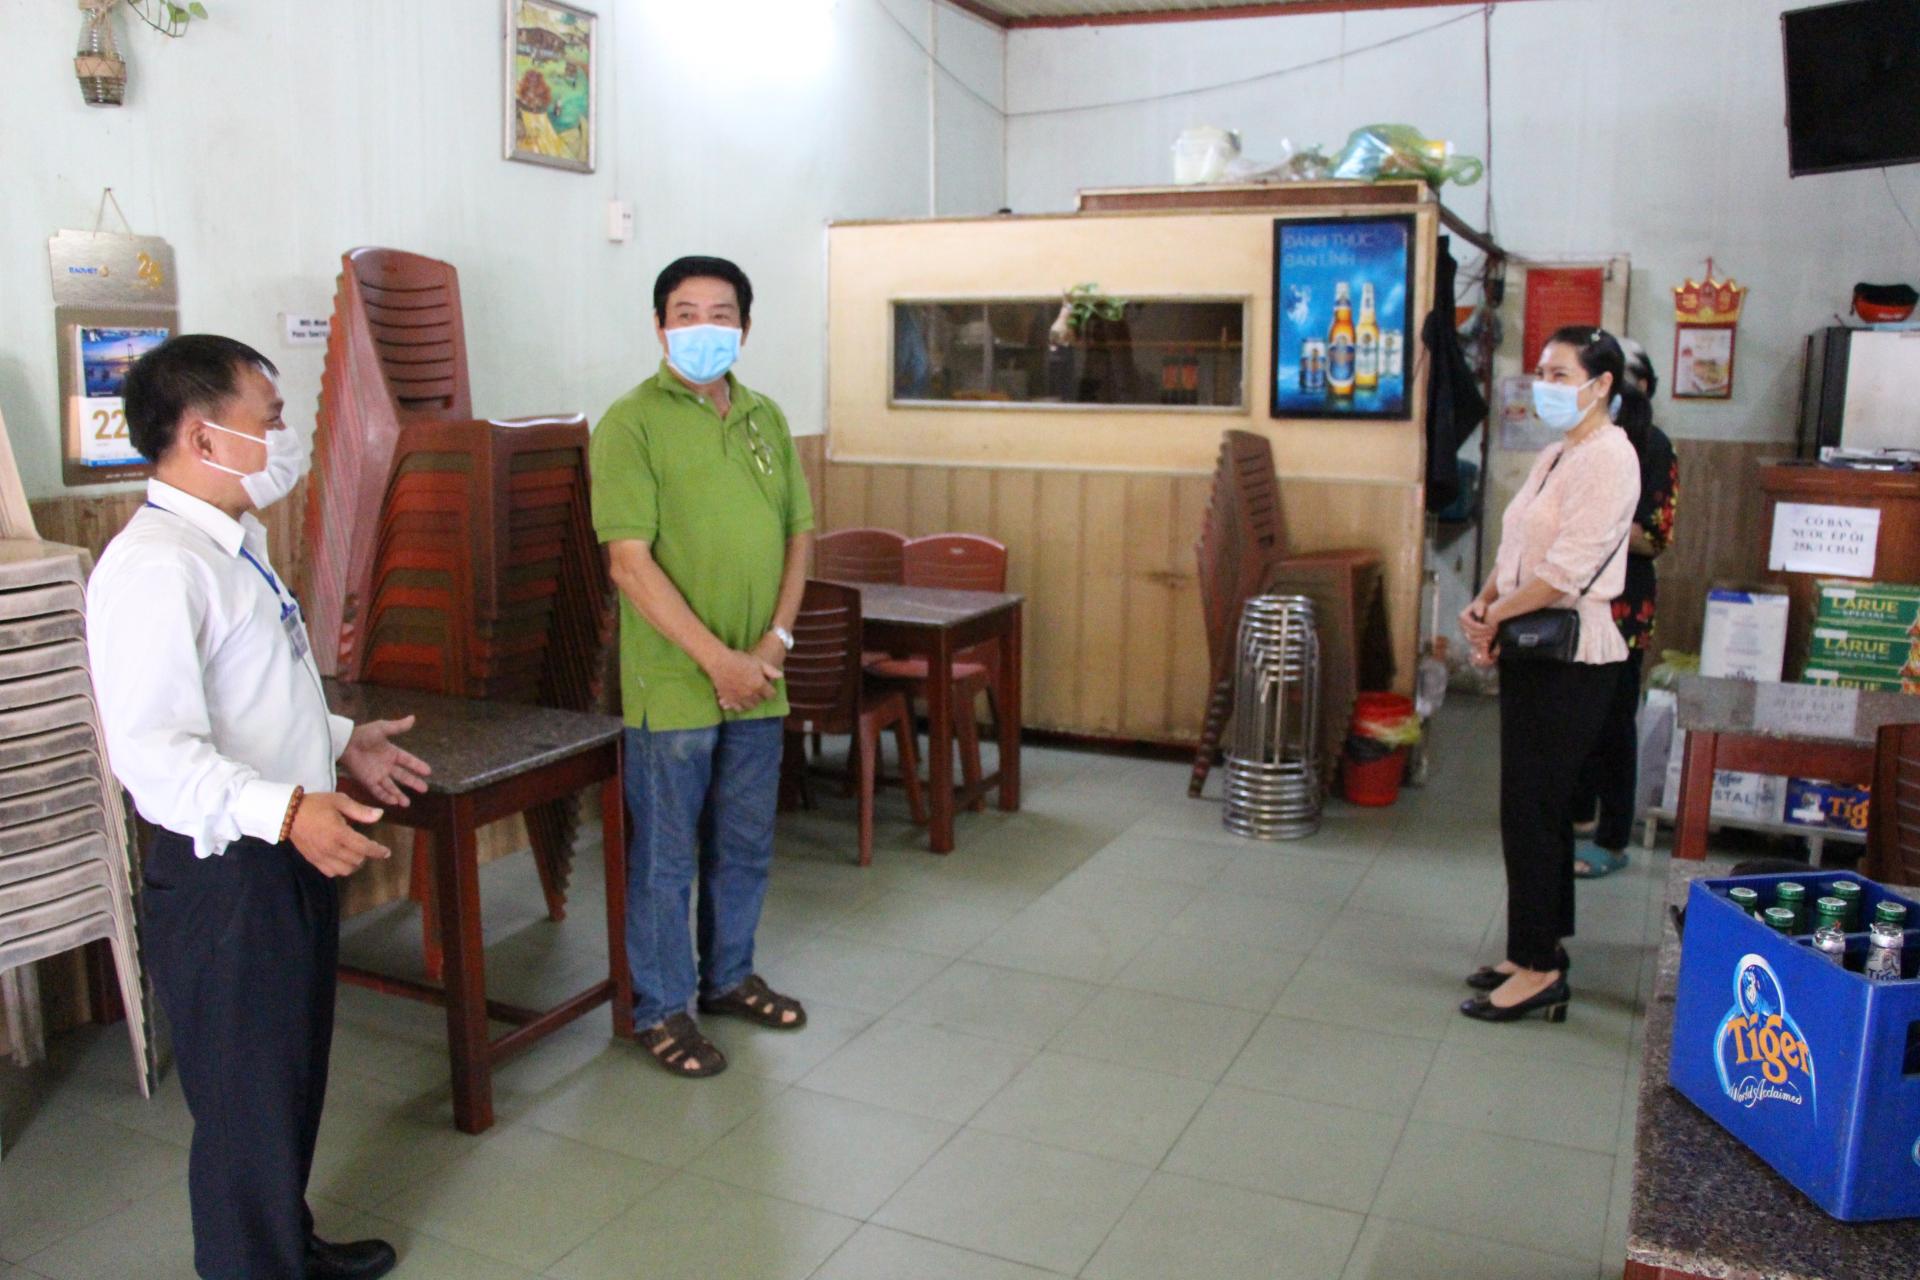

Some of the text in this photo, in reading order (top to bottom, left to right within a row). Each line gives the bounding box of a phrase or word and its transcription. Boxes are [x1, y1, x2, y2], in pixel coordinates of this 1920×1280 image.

[93, 408, 130, 440] 22
[1832, 597, 1898, 613] LARUE
[1842, 609, 1884, 619] SPECIAL
[1824, 638, 1889, 655] LARUE
[1834, 650, 1876, 660] SPECIAL
[1828, 797, 1869, 829] Tig
[1727, 1011, 1810, 1085] Tiger
[1727, 1078, 1803, 1106] World Acclaimed
